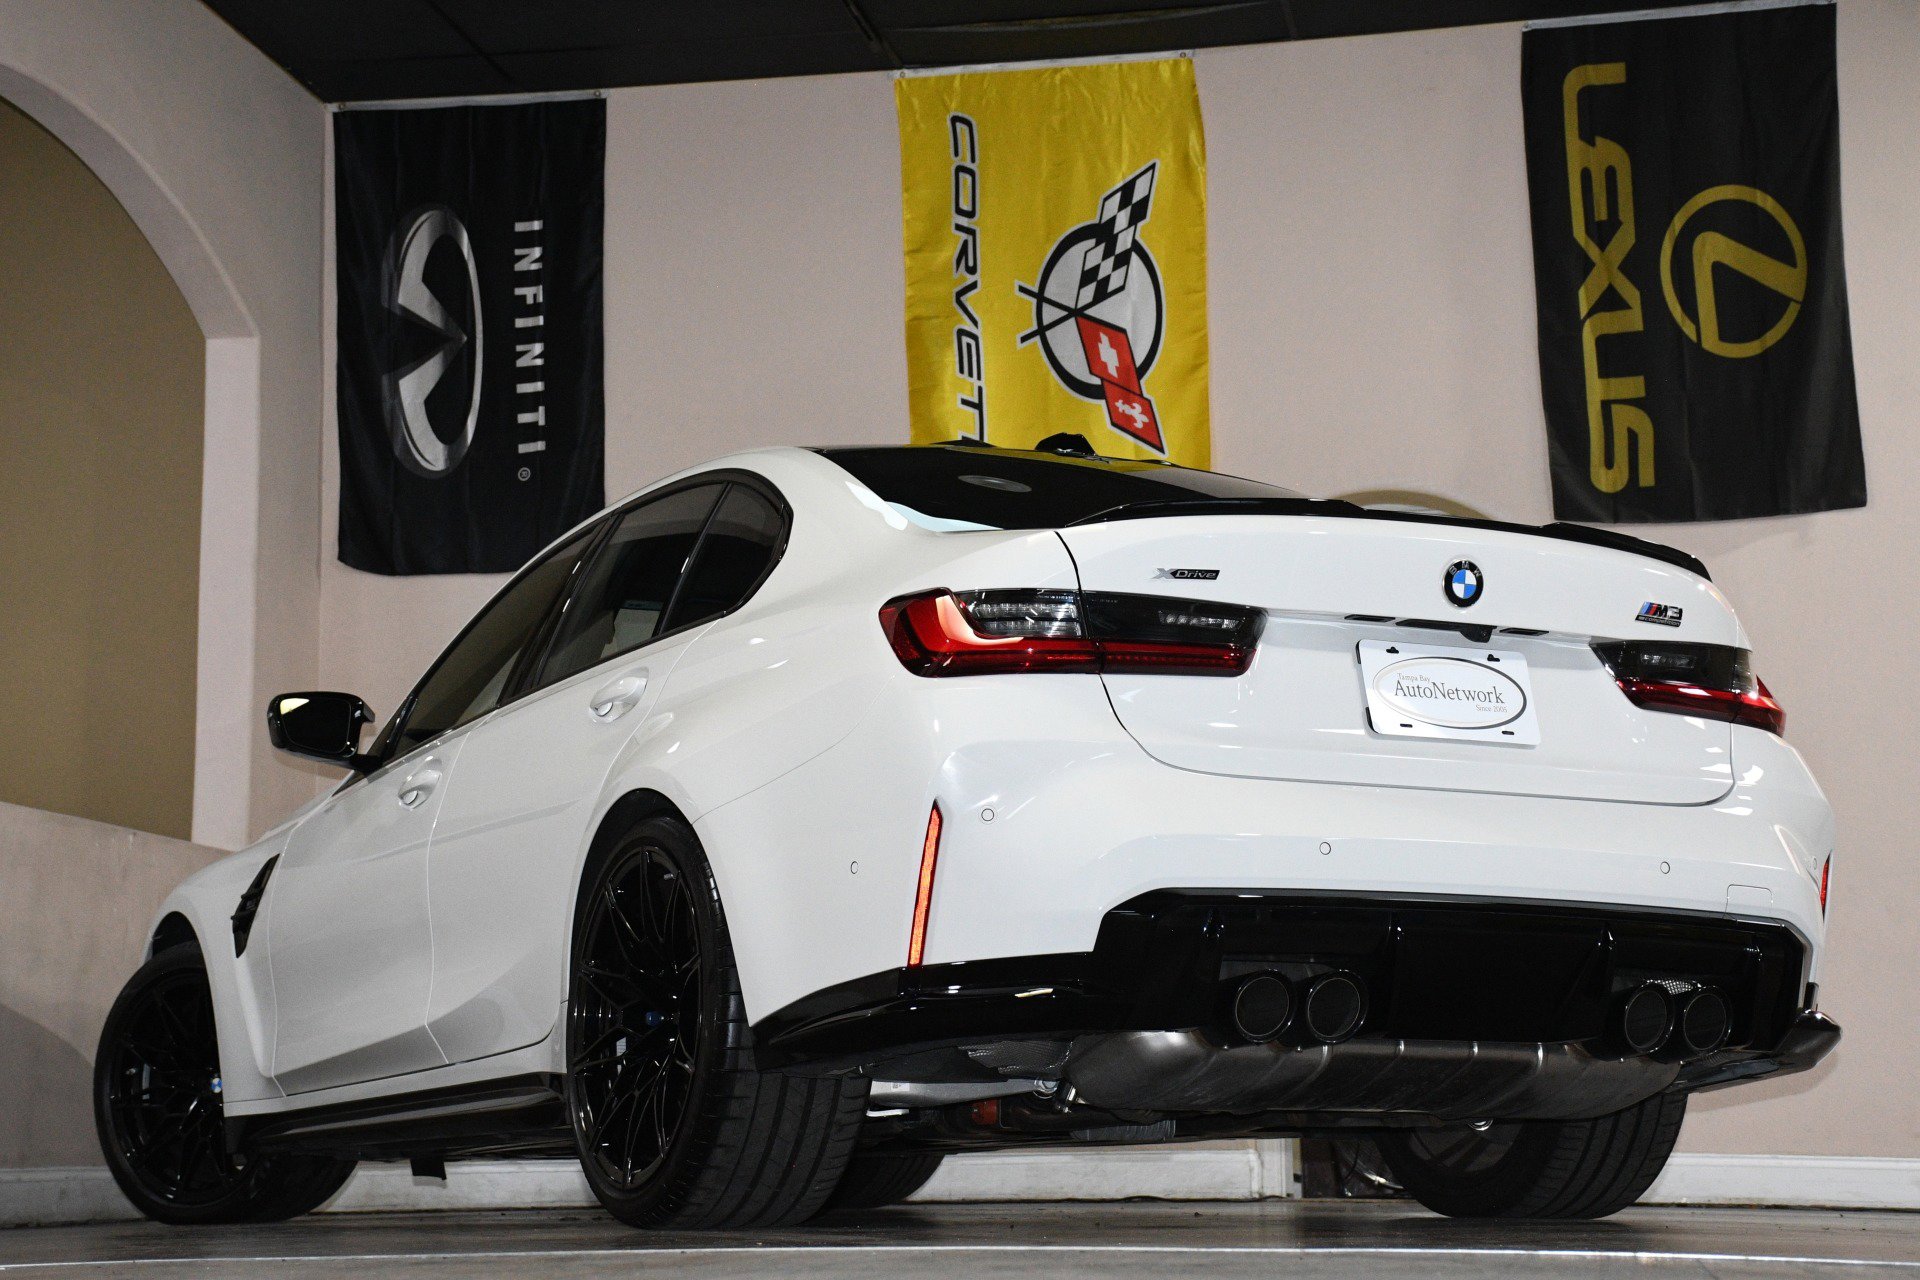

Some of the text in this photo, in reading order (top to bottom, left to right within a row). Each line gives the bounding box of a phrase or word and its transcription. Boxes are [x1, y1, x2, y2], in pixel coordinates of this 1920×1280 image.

[1563, 62, 1655, 494] LEXUS
[514, 220, 546, 454] INFINITI
[1397, 673, 1431, 683] Tampa Bay
[1395, 680, 1505, 703] AutoNetwork
[1475, 704, 1492, 712] Since
